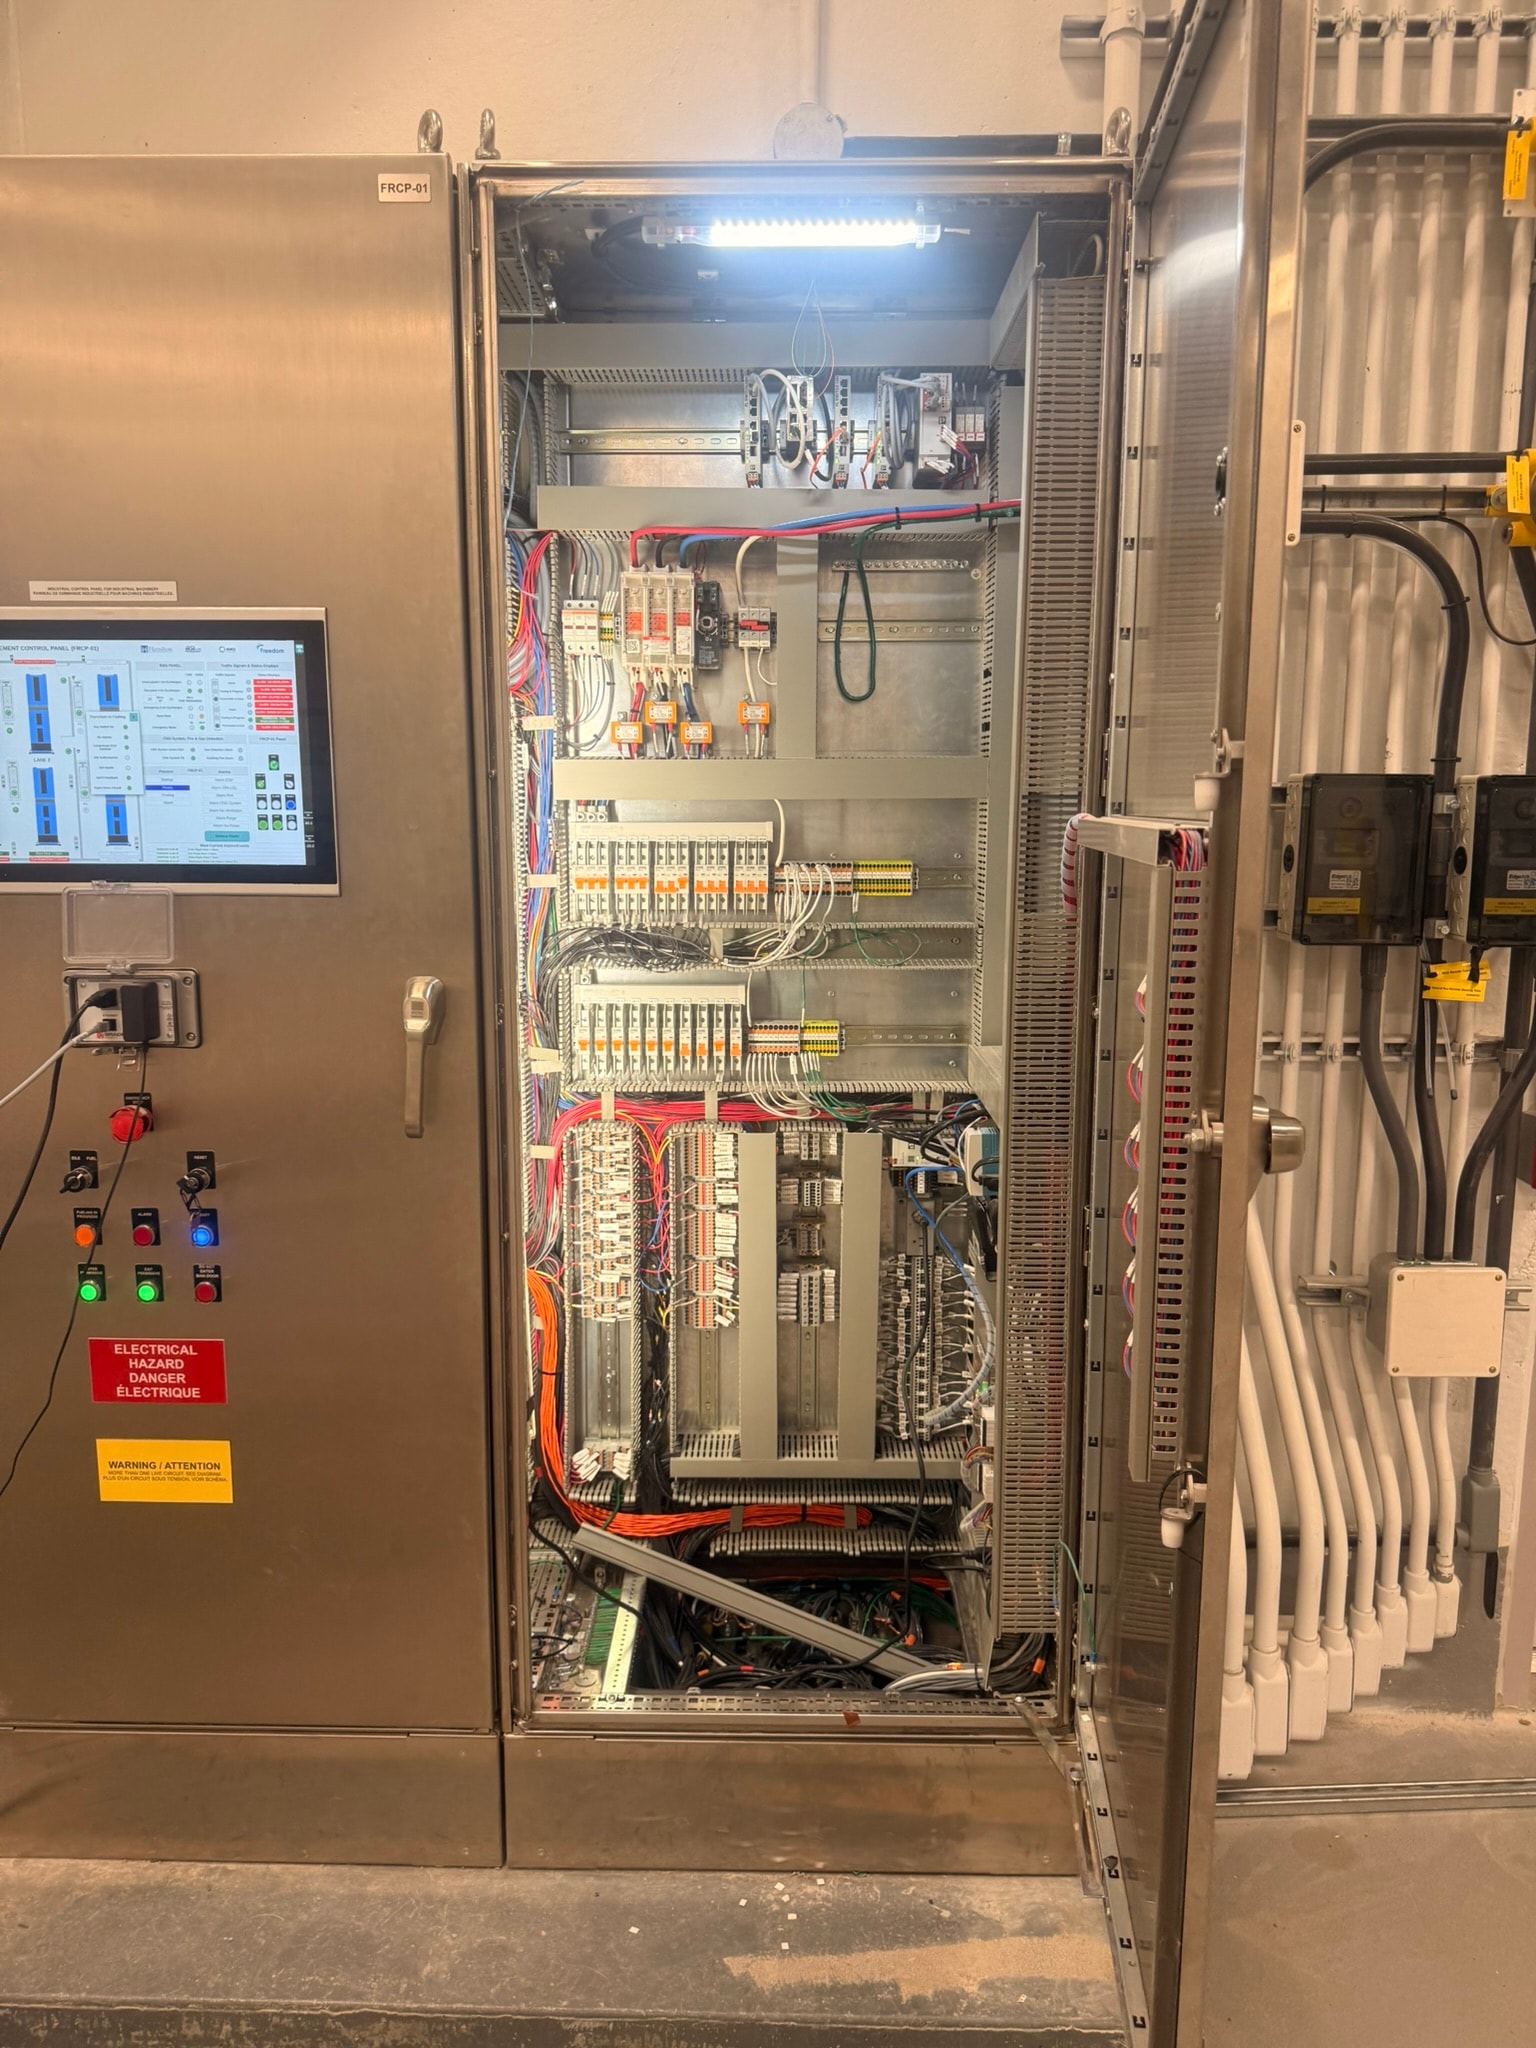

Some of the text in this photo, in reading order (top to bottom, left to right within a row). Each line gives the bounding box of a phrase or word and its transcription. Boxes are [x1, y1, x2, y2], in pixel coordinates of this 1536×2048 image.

[381, 183, 428, 193] FRCP-01
[114, 1344, 198, 1355] ELECTRICAL
[129, 1358, 184, 1369] HAZARD
[129, 1372, 186, 1384] DANGER
[116, 1384, 201, 1398] ÉLECTRIQUE
[108, 1461, 157, 1470] WARNING
[164, 1462, 221, 1470] ATTENTION
